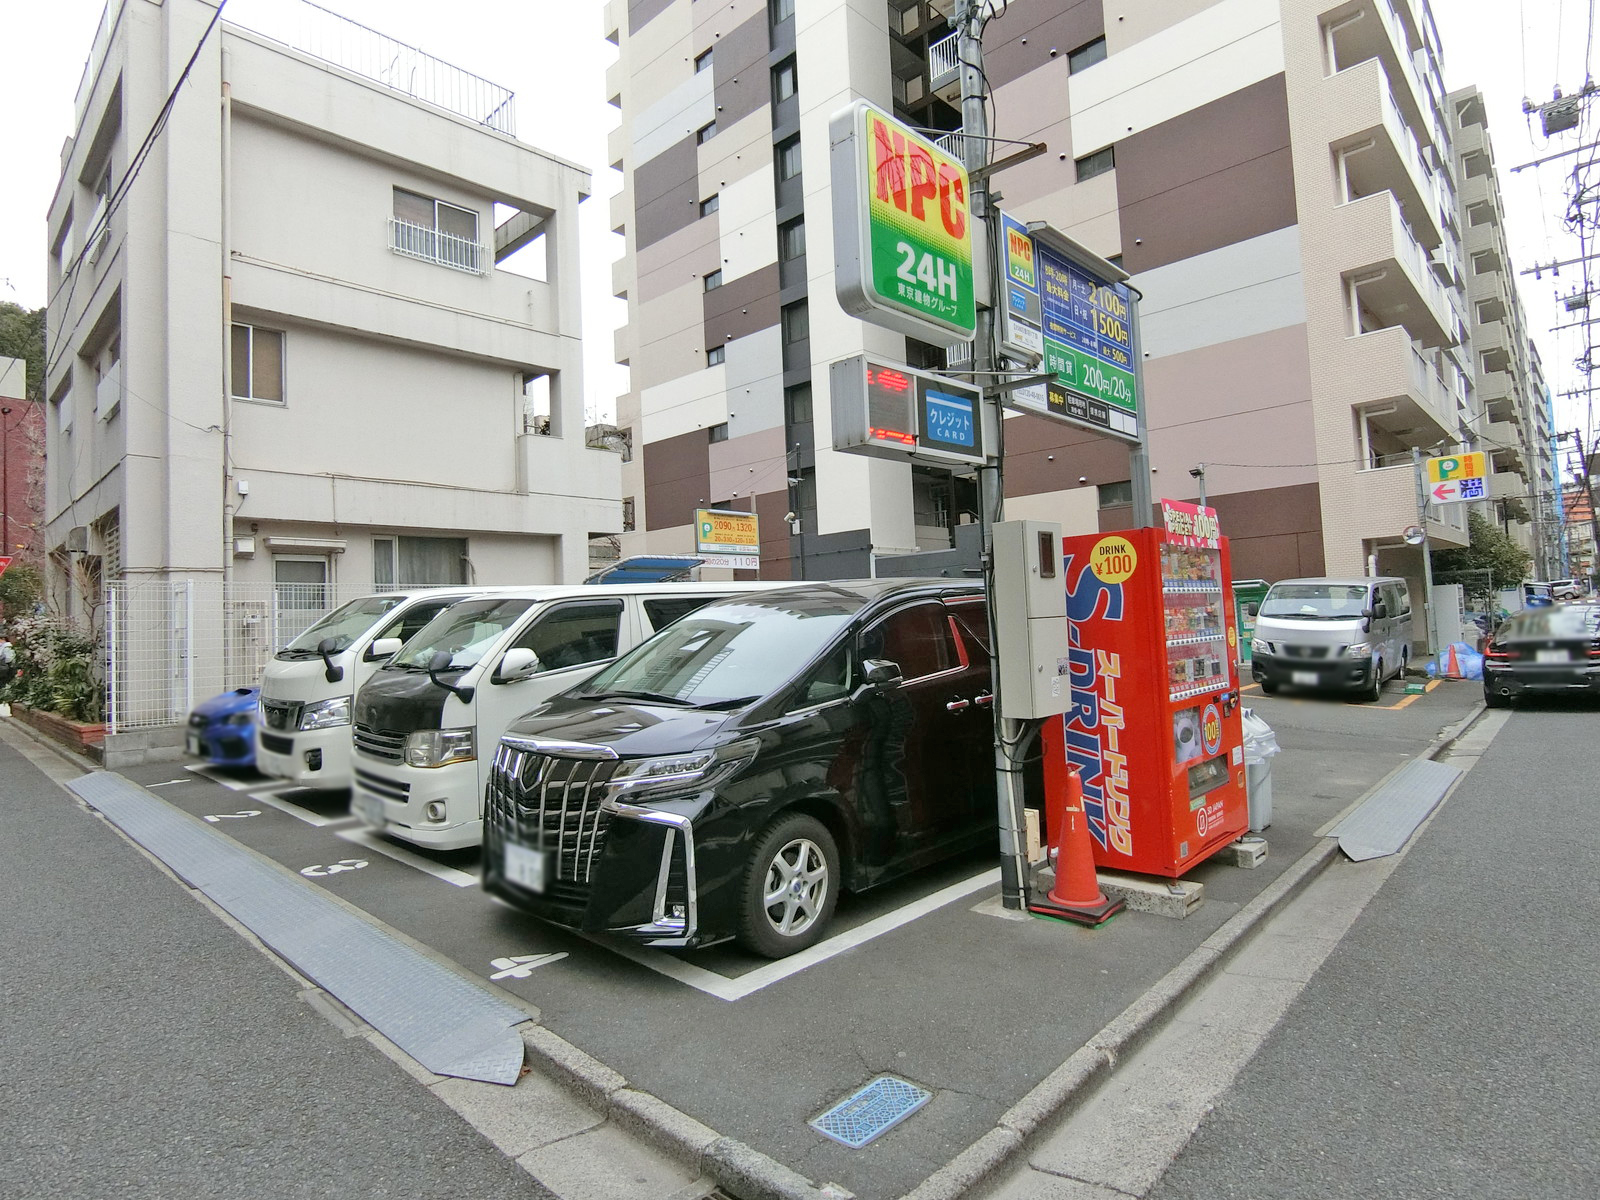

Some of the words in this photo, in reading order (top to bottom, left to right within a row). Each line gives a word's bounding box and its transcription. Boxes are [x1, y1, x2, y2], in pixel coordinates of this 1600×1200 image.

[873, 118, 965, 240] NPC
[1010, 232, 1031, 261] NPC
[896, 241, 957, 302] 24H
[1014, 266, 1030, 282] 24H
[897, 282, 958, 316] 東京建物グループ
[1088, 281, 1127, 320] 2100円
[1090, 308, 1129, 346] 1500円
[1049, 354, 1073, 376] 時間貸
[1083, 364, 1132, 402] 200円/20分
[930, 408, 970, 430] クレジット
[937, 428, 965, 441] CARD
[1169, 508, 1193, 525] SPECIAL
[1099, 544, 1126, 556] DRINK
[1095, 554, 1132, 576] ¥100
[1097, 649, 1132, 856] スーパードリンク
